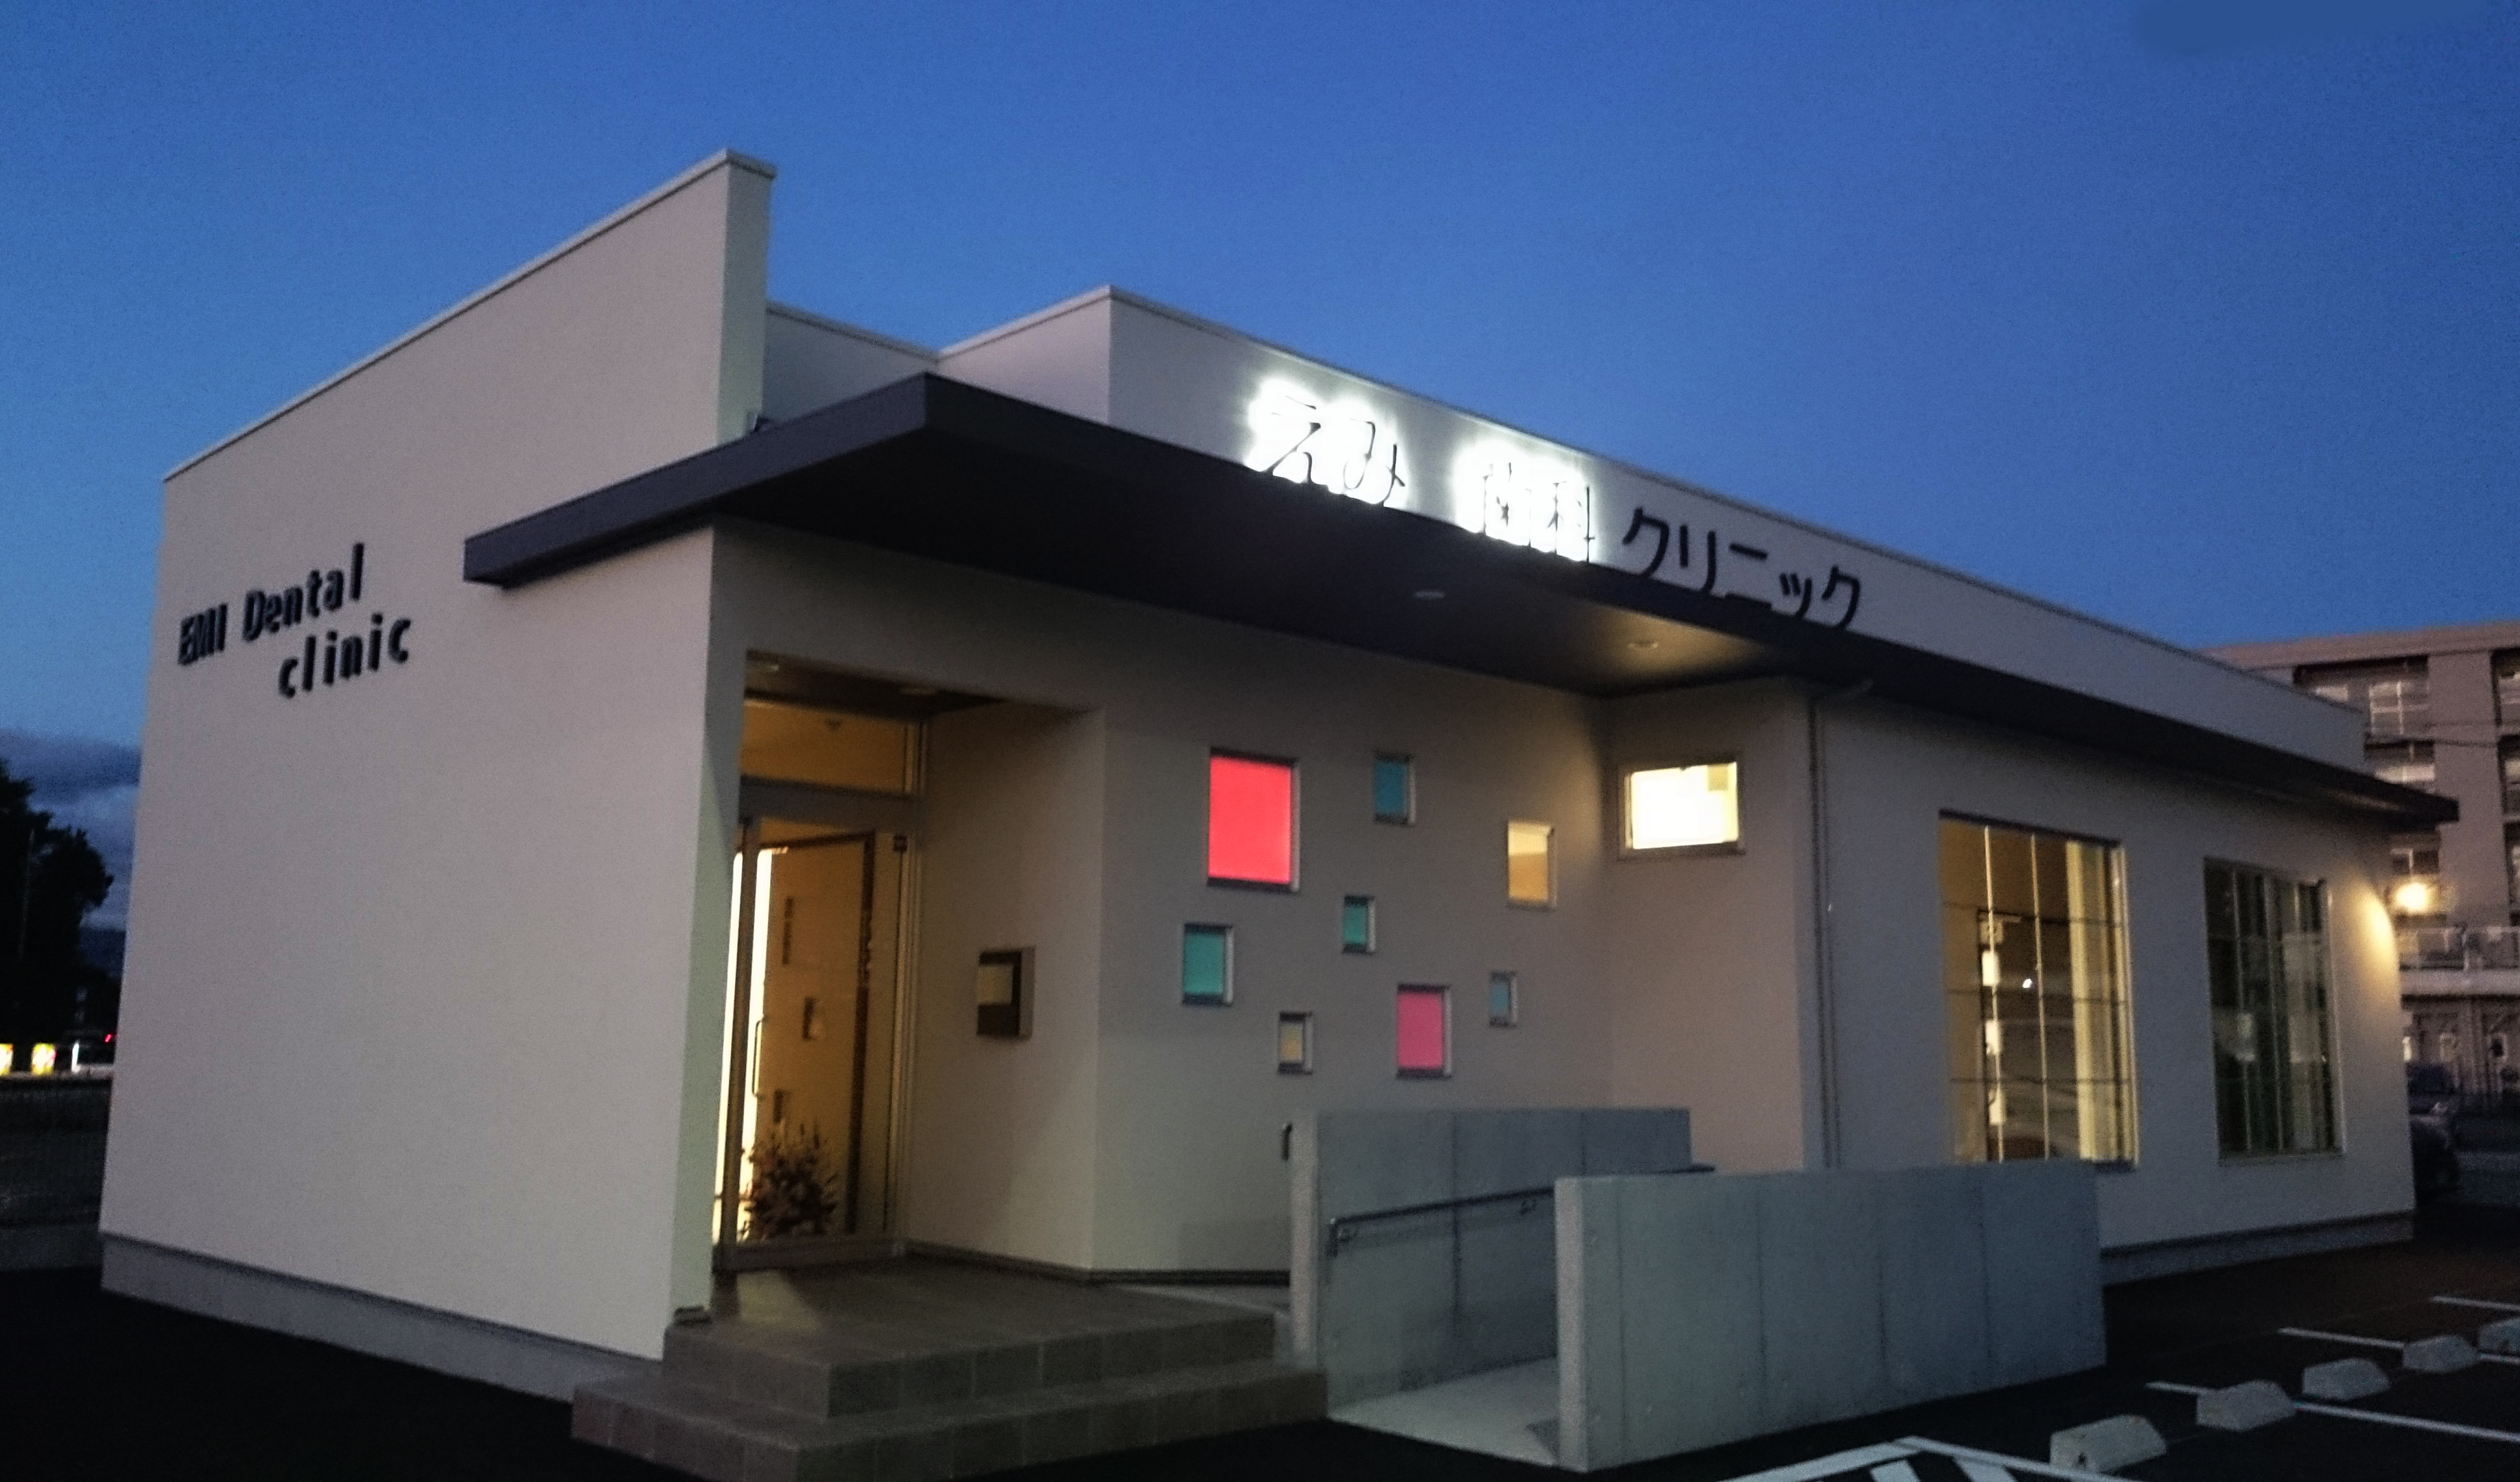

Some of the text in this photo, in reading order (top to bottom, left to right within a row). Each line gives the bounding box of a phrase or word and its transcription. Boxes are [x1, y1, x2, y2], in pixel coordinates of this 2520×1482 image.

[178, 541, 364, 665] EMI Dental
[1622, 507, 1860, 630] クリニック
[278, 612, 411, 698] clinic
